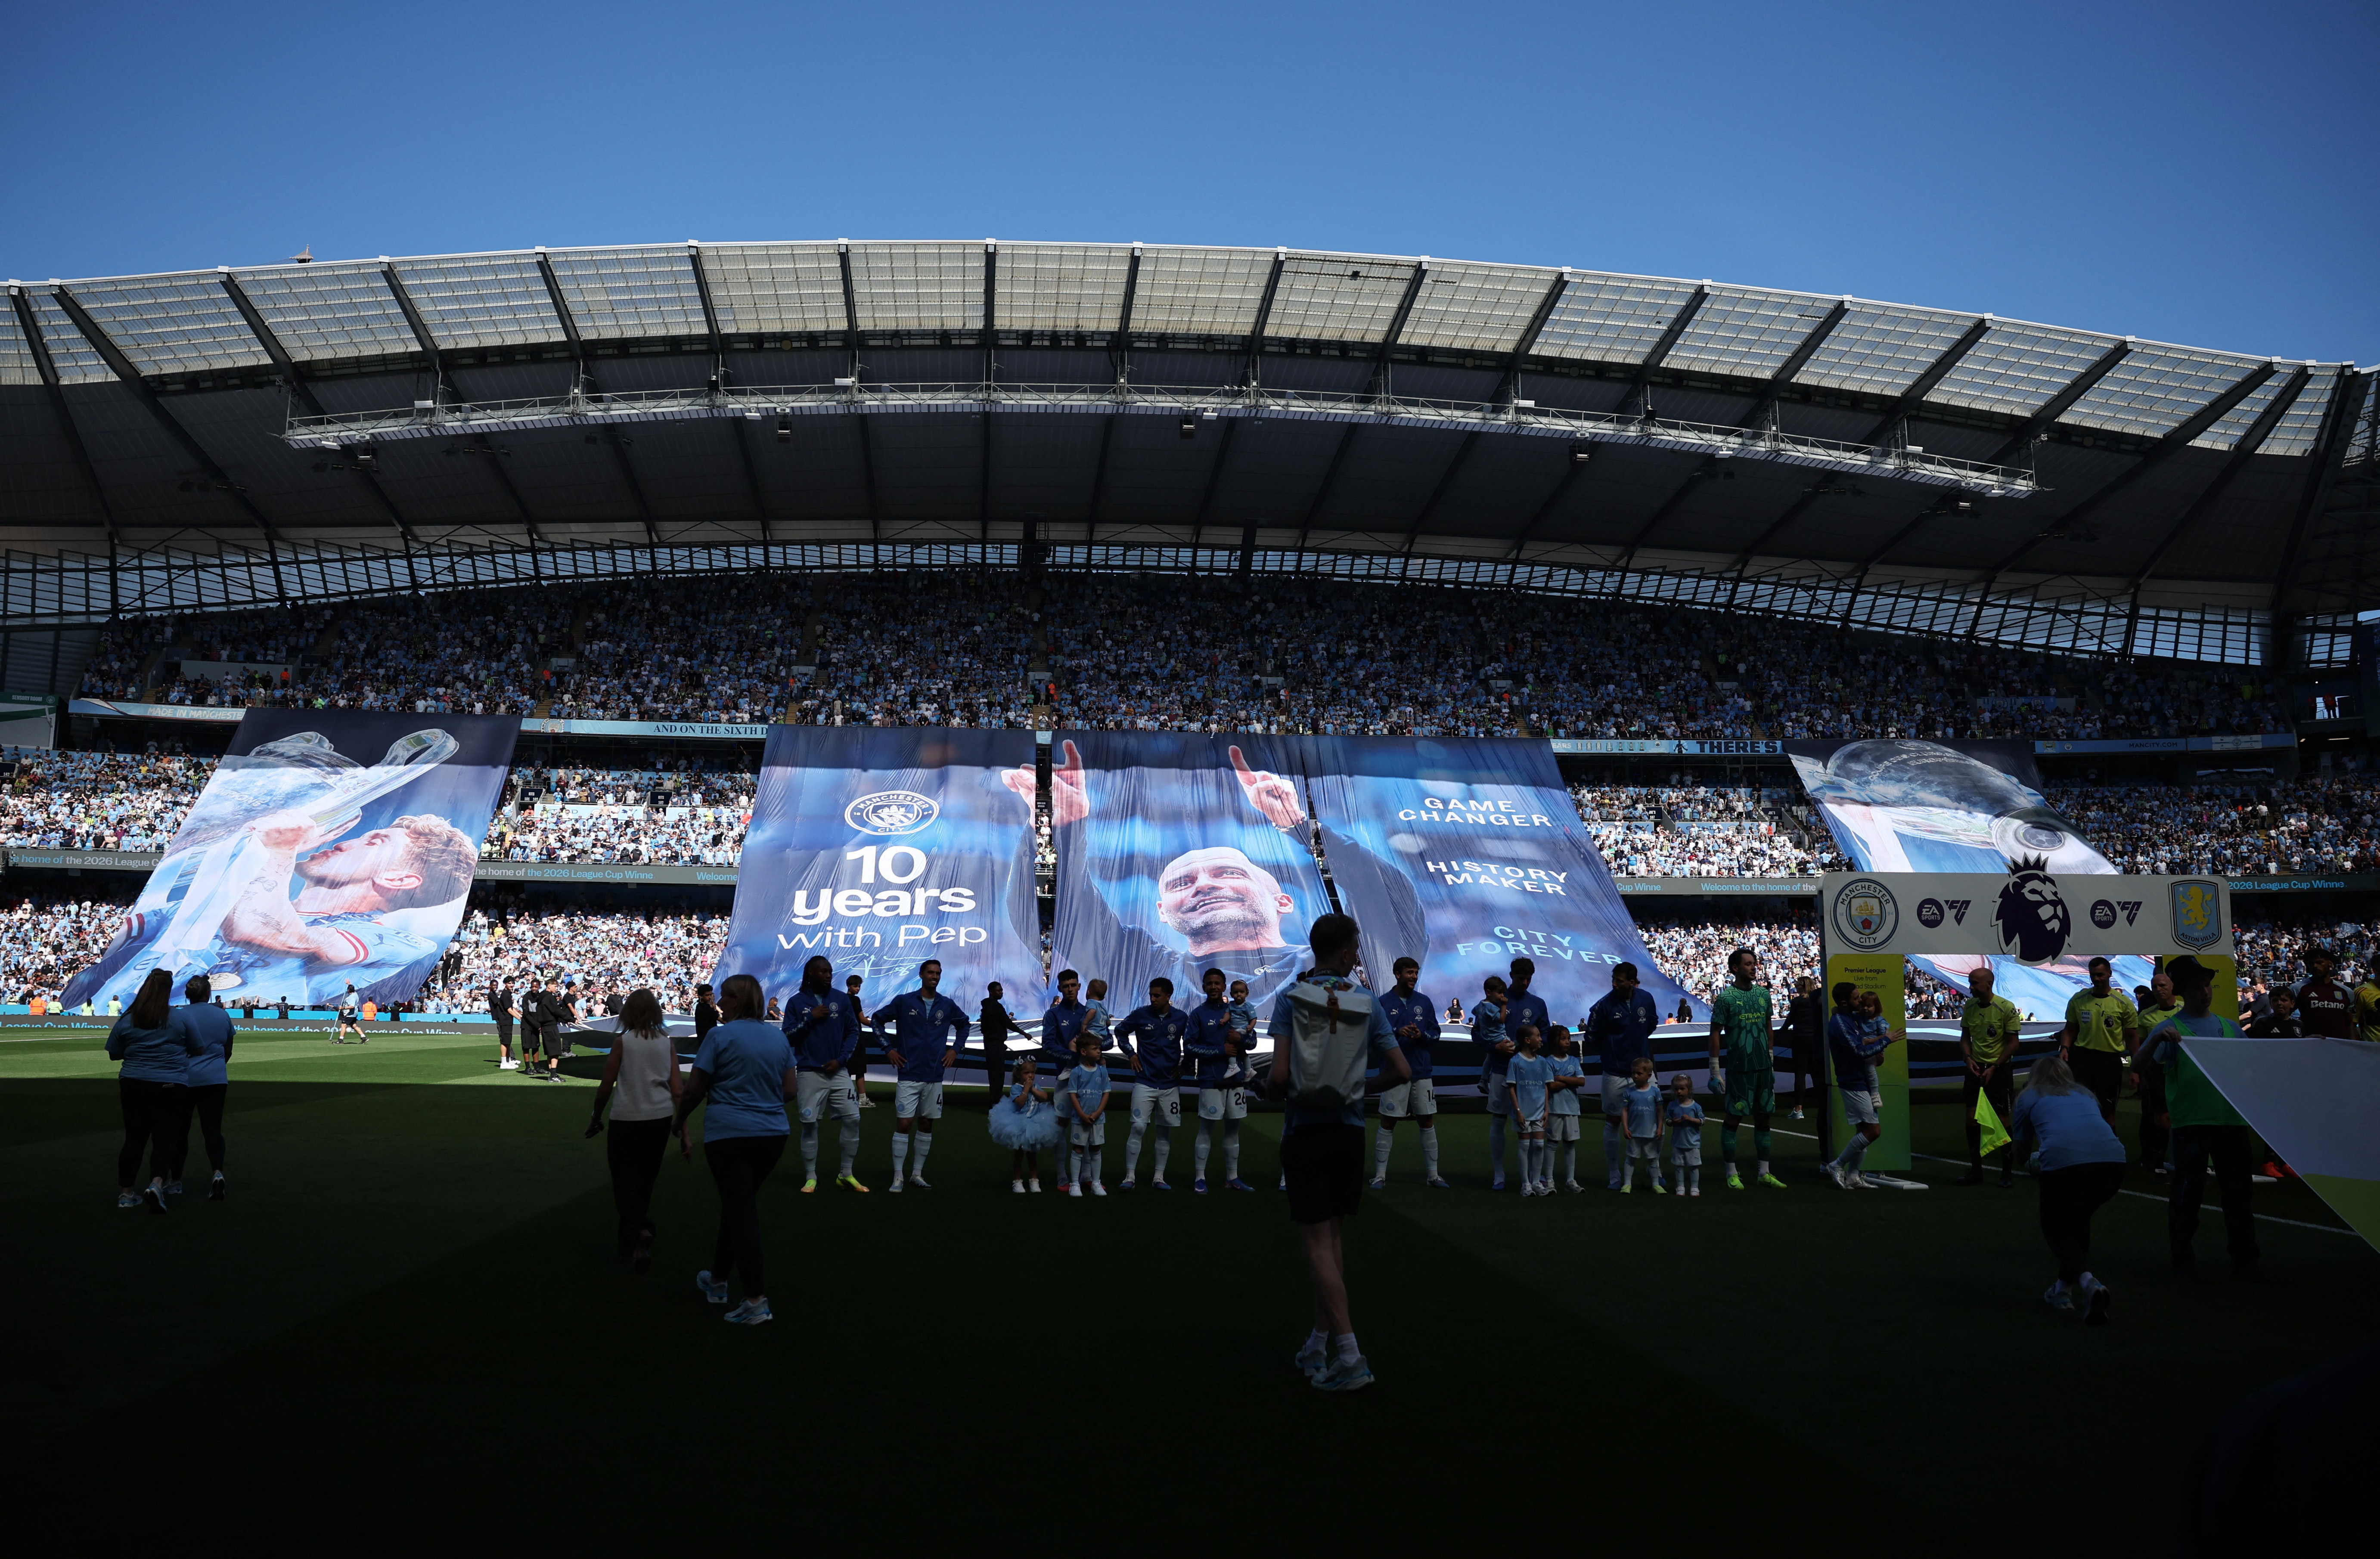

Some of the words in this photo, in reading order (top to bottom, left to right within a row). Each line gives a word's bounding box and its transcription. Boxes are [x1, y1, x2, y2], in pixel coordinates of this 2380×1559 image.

[147, 707, 173, 716] MADE
[177, 708, 187, 718] IN
[654, 725, 677, 733] AND
[680, 725, 696, 733] ON
[698, 726, 721, 734] THE
[724, 726, 758, 735] SIXTH
[1696, 741, 1778, 753] THERE'S
[857, 794, 929, 809] MANCHESTER
[1424, 798, 1516, 812] GAME
[1398, 809, 1552, 827] CHANGER
[22, 855, 51, 863] home
[53, 855, 64, 864] of
[66, 856, 82, 865] the
[84, 856, 113, 865] 2026
[115, 857, 150, 868] League
[846, 845, 927, 884] 10
[474, 867, 486, 875] he
[488, 867, 514, 876] home
[516, 868, 525, 876] of
[527, 868, 542, 877] the
[543, 869, 569, 877] 2026
[571, 870, 603, 880] League
[605, 870, 623, 880] Cup
[625, 871, 654, 879] Winne
[696, 872, 738, 881] Welcome
[1426, 861, 1567, 883] HISTORY
[1444, 873, 1567, 896] MAKER
[1617, 883, 1633, 892] Cup
[1701, 883, 1740, 891] Welcome
[1767, 883, 1790, 891] home
[1792, 883, 1801, 891] of
[1802, 883, 1816, 891] the
[2228, 881, 2253, 890] 2026
[2255, 881, 2289, 891] League
[2291, 880, 2310, 890] Cup
[1840, 884, 1890, 905] MANCHESTER
[791, 887, 976, 925] years
[1922, 905, 1940, 915] EA
[2095, 906, 2112, 916] EA
[777, 926, 881, 949] with
[898, 924, 987, 947] Pep
[1494, 926, 1572, 946] CITY
[2180, 932, 2200, 942] ASTON
[2201, 932, 2216, 942] VILLA
[1456, 941, 1623, 964] FOREVER
[2311, 1000, 2345, 1009] Betano
[1234, 1092, 1246, 1106] 26
[1170, 1102, 1181, 1114] 8
